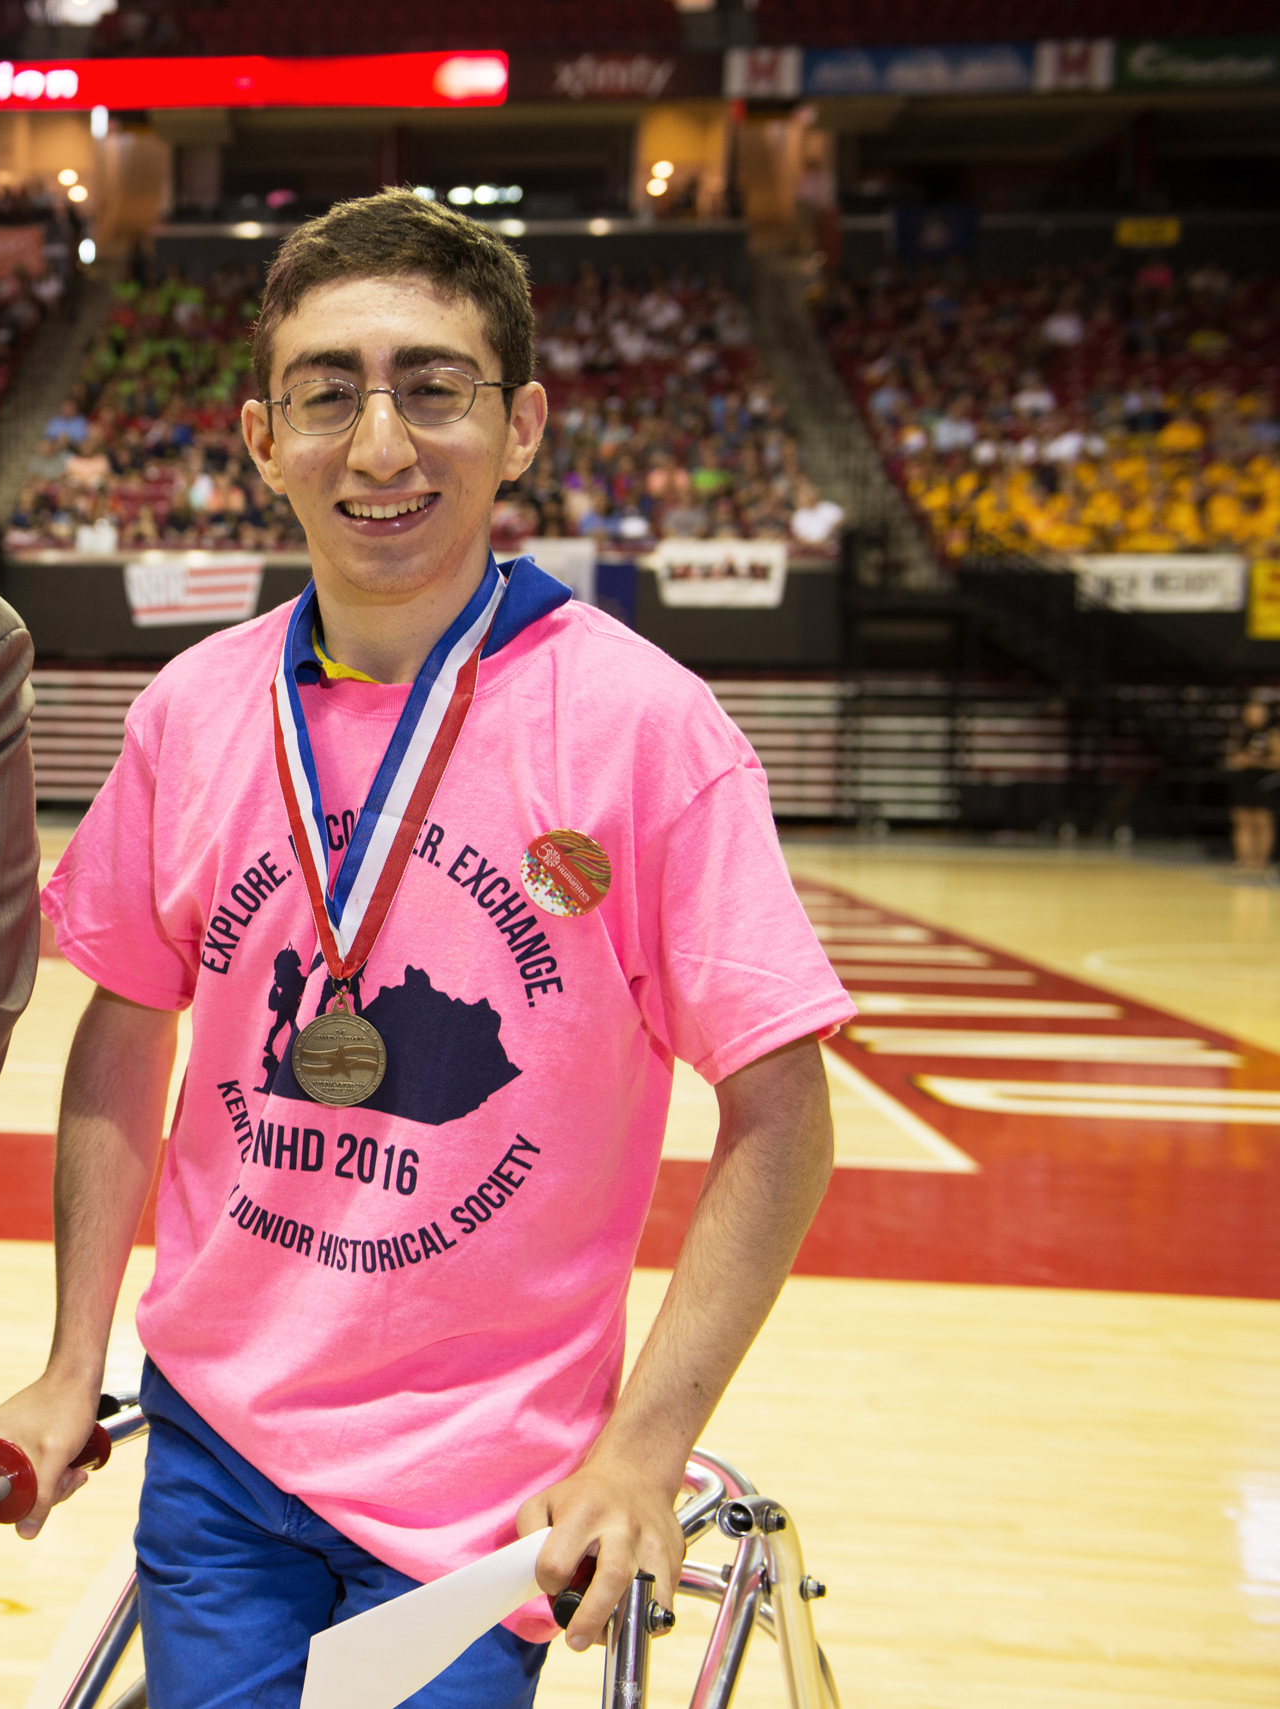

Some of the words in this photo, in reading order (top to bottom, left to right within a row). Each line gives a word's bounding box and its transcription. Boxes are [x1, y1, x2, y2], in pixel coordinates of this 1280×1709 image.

[201, 852, 293, 975] EXPLORE.
[447, 844, 564, 1008] EXCHANGE.
[556, 864, 591, 902] Humanities
[229, 1195, 314, 1257] JUNIOR
[317, 1221, 457, 1273] HISTORICAL
[450, 1133, 540, 1234] SOCIETY
[252, 1119, 325, 1172] NHD
[335, 1133, 419, 1195] 2016
